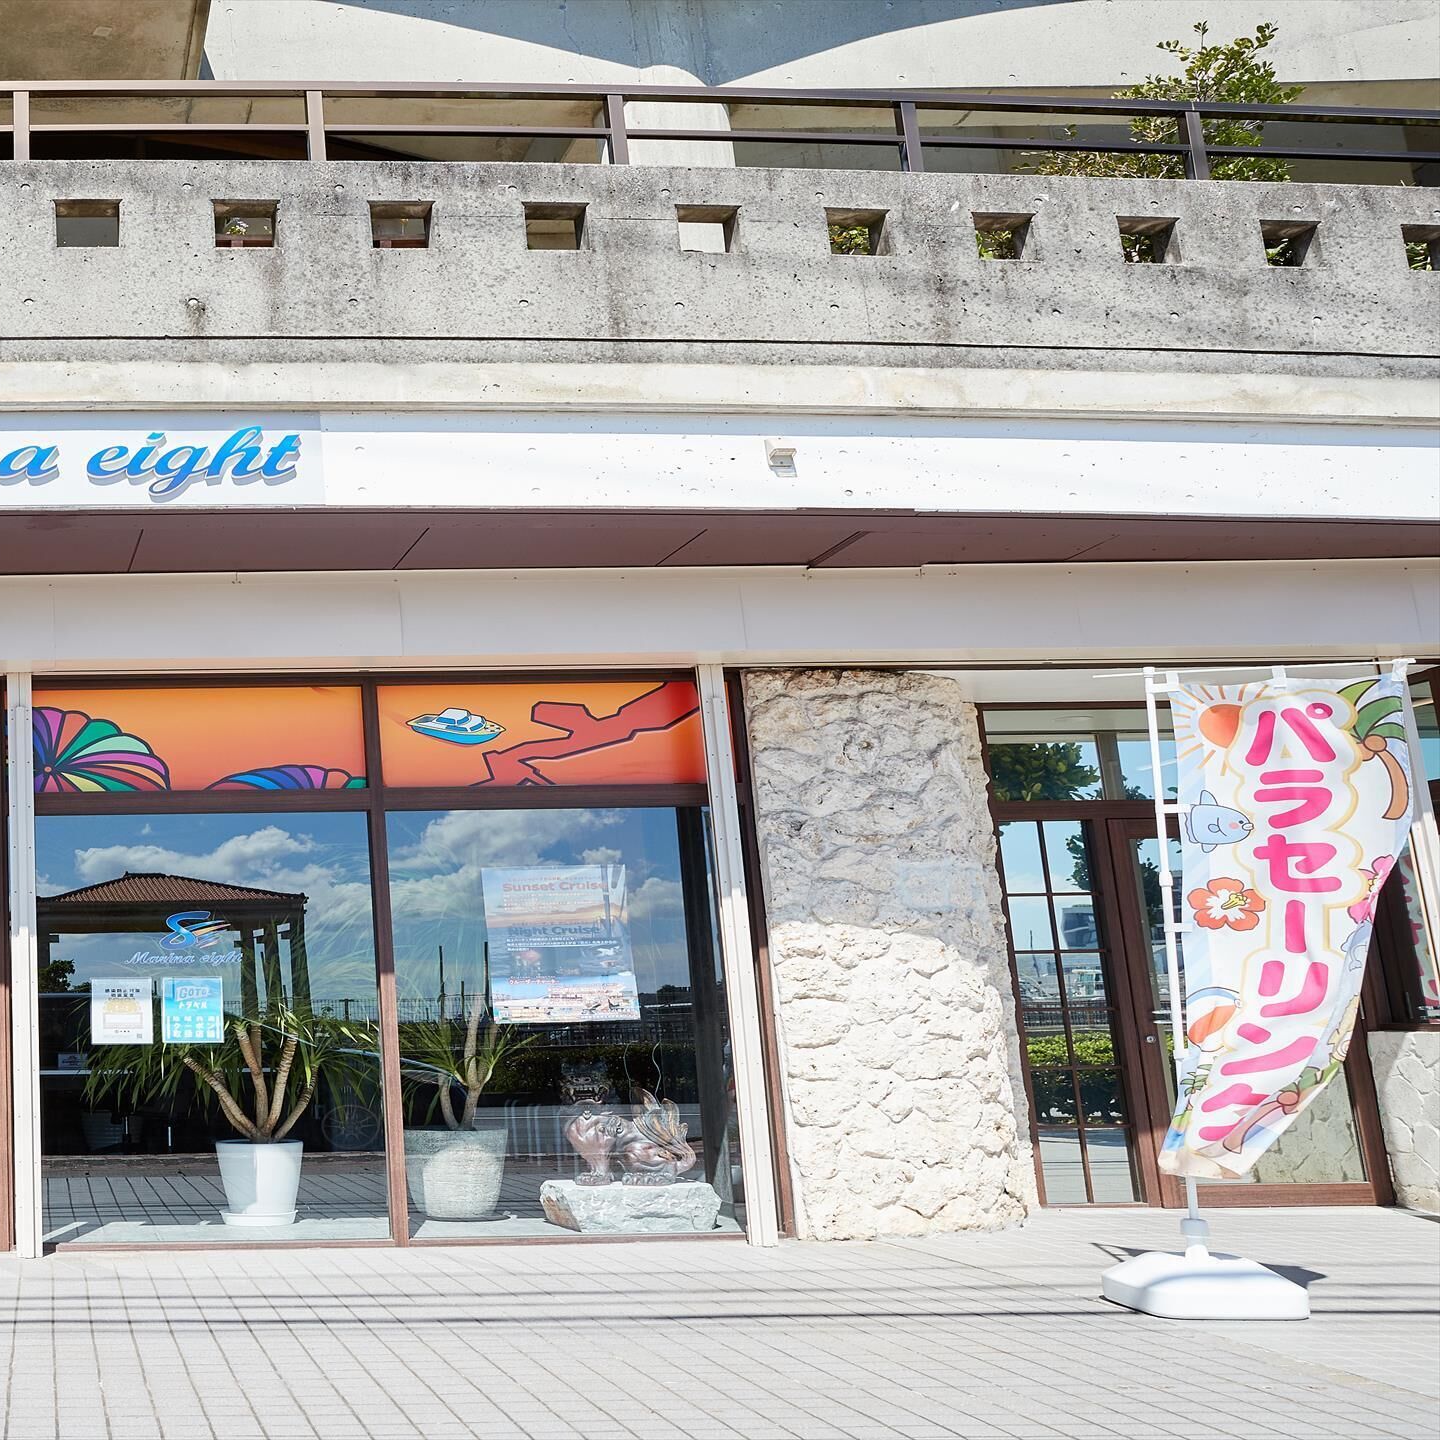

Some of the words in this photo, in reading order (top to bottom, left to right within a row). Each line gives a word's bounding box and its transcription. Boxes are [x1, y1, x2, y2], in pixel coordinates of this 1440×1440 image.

[86, 426, 302, 502] eight
[503, 883, 554, 892] Sunset
[559, 881, 608, 891] Cruise
[508, 927, 550, 937] Night
[552, 926, 600, 936] Cruise
[125, 951, 195, 964] Marina
[200, 951, 244, 966] eight
